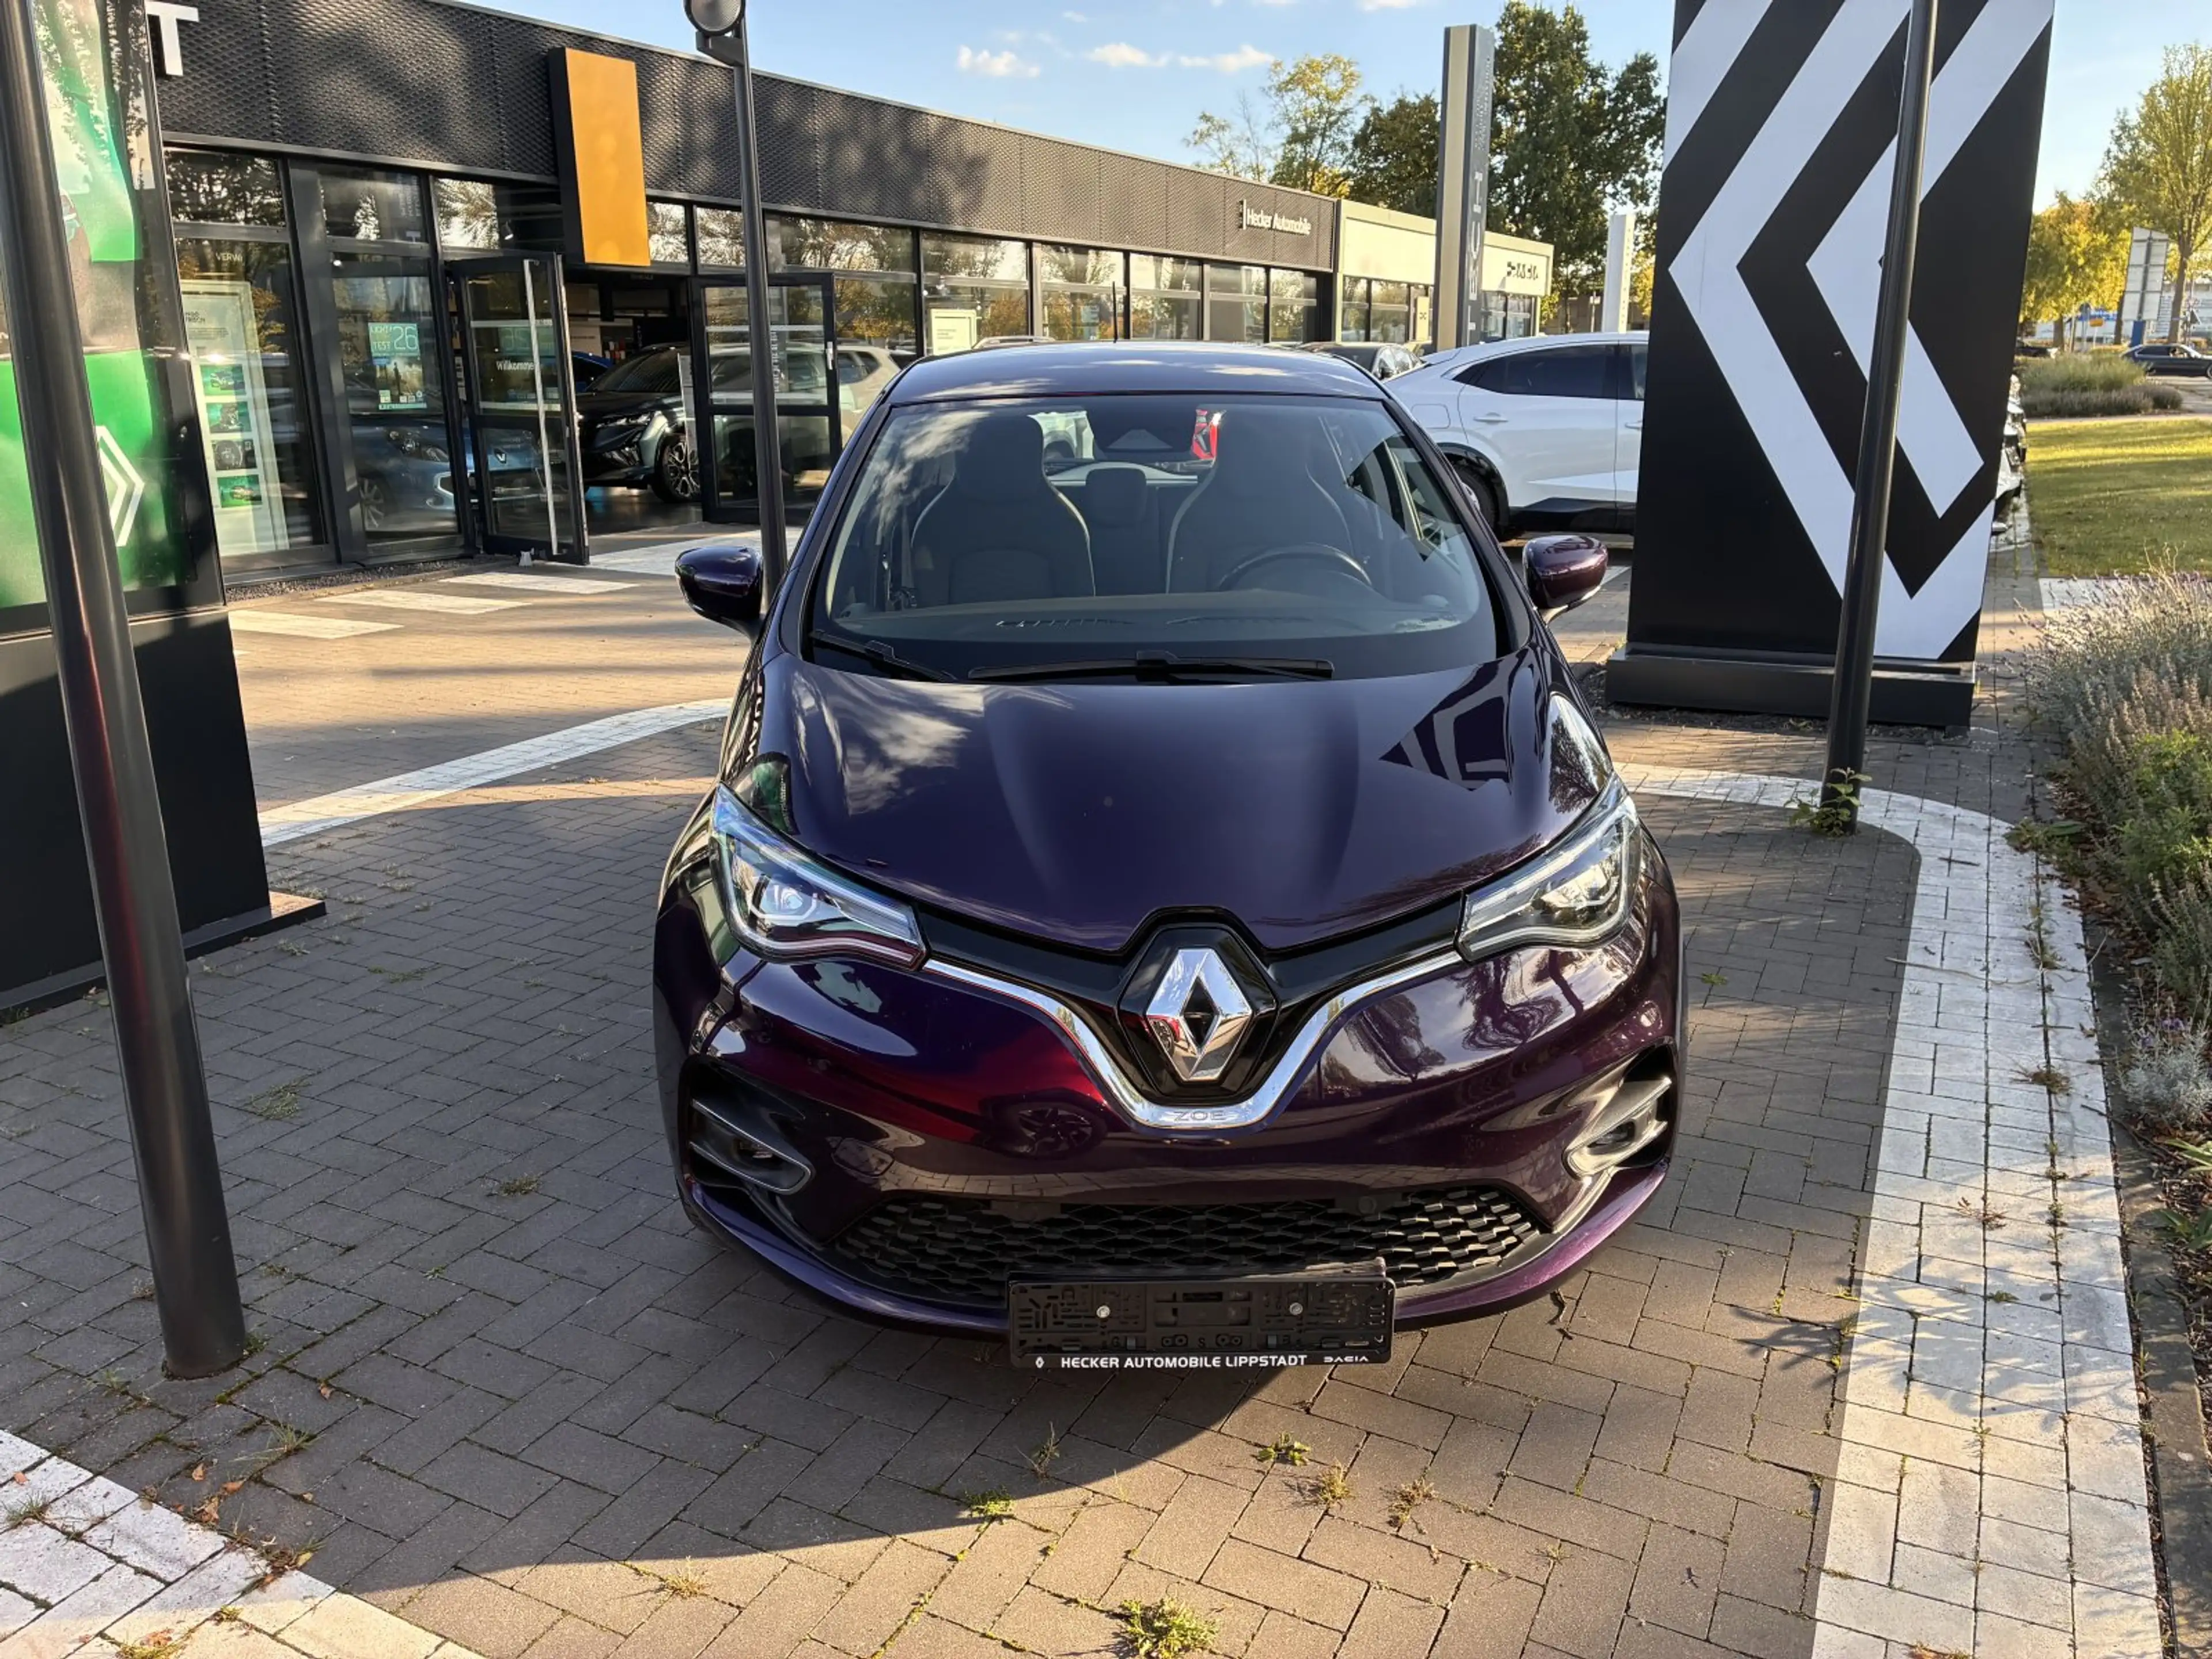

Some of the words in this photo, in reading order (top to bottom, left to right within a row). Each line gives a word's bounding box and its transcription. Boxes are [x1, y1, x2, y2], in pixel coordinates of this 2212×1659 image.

[1247, 209, 1272, 228] Hecker
[1272, 213, 1312, 235] Automobile
[1173, 1110, 1228, 1122] ZOE
[1061, 1357, 1119, 1368] HECKER
[1124, 1356, 1221, 1368] AUTOMOBILE
[1225, 1354, 1307, 1368] LIPPSTADT
